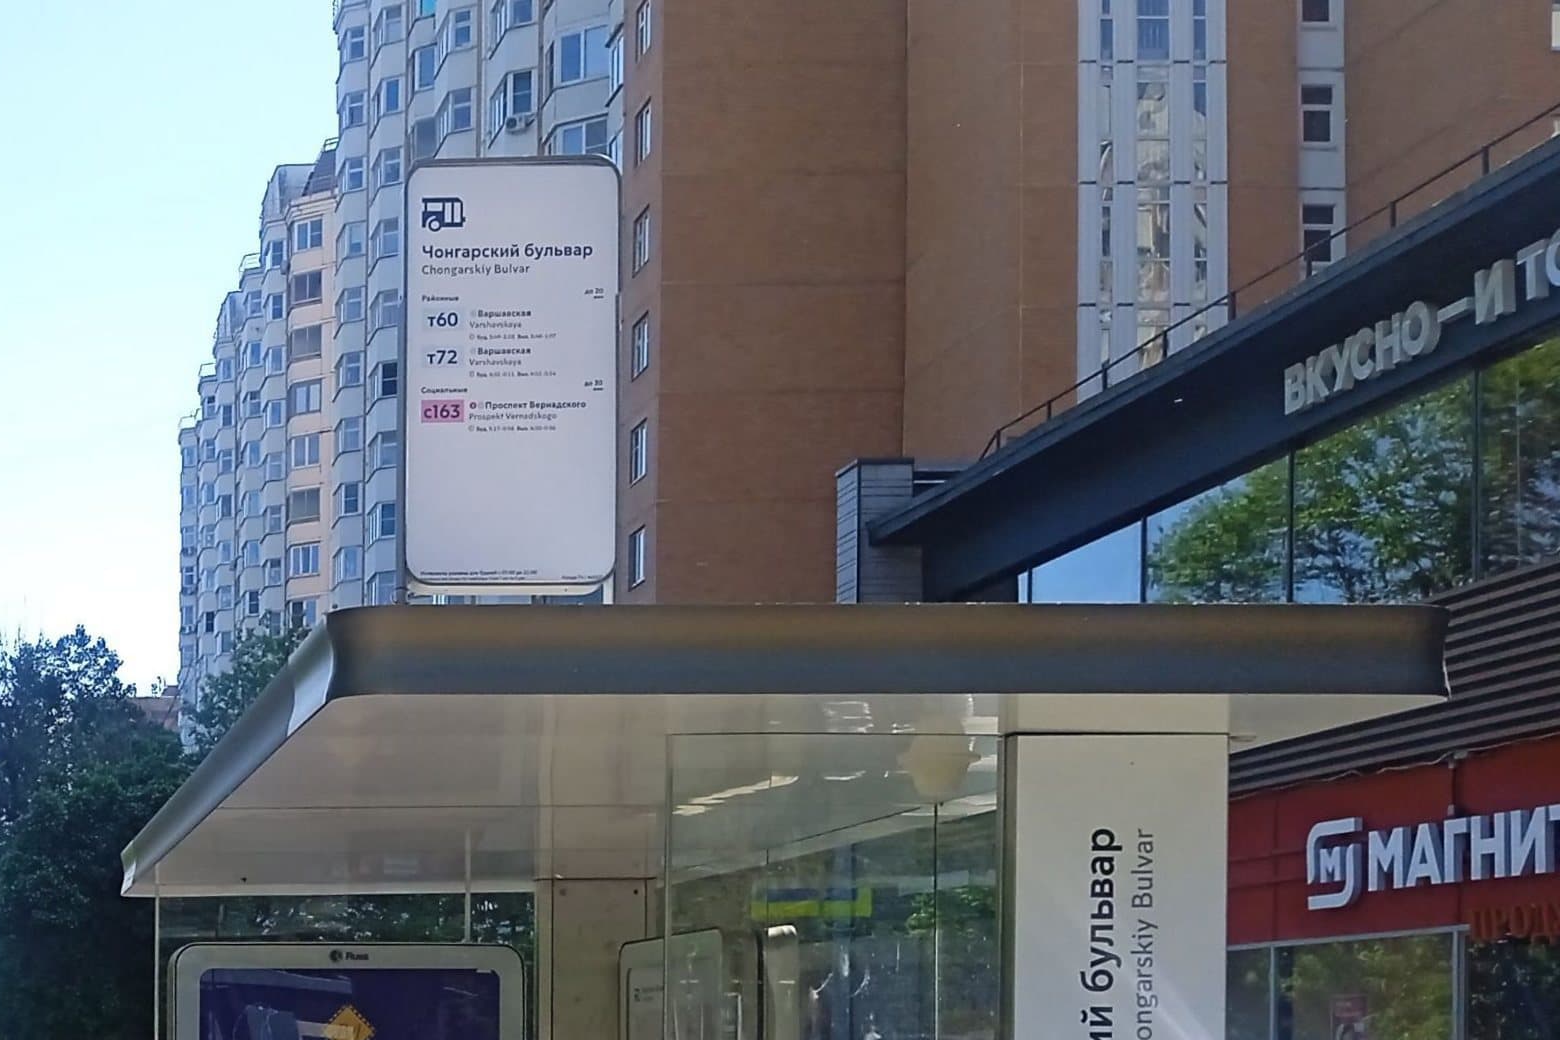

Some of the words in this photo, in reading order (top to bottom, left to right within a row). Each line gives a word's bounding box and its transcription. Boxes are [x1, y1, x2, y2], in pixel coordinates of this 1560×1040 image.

[422, 244, 520, 261] Чонгарский
[524, 243, 593, 260] бульвар
[421, 264, 492, 277] Chongarskiy
[494, 264, 530, 274] Bulvar
[477, 309, 532, 319] Варшавская
[477, 347, 532, 356] Варшавская
[1284, 300, 1441, 416] ВКУСНО
[485, 401, 527, 410] Проспект
[529, 400, 586, 410] Вернадского
[1130, 828, 1156, 908] Bulvar
[1079, 827, 1123, 994] бульвар
